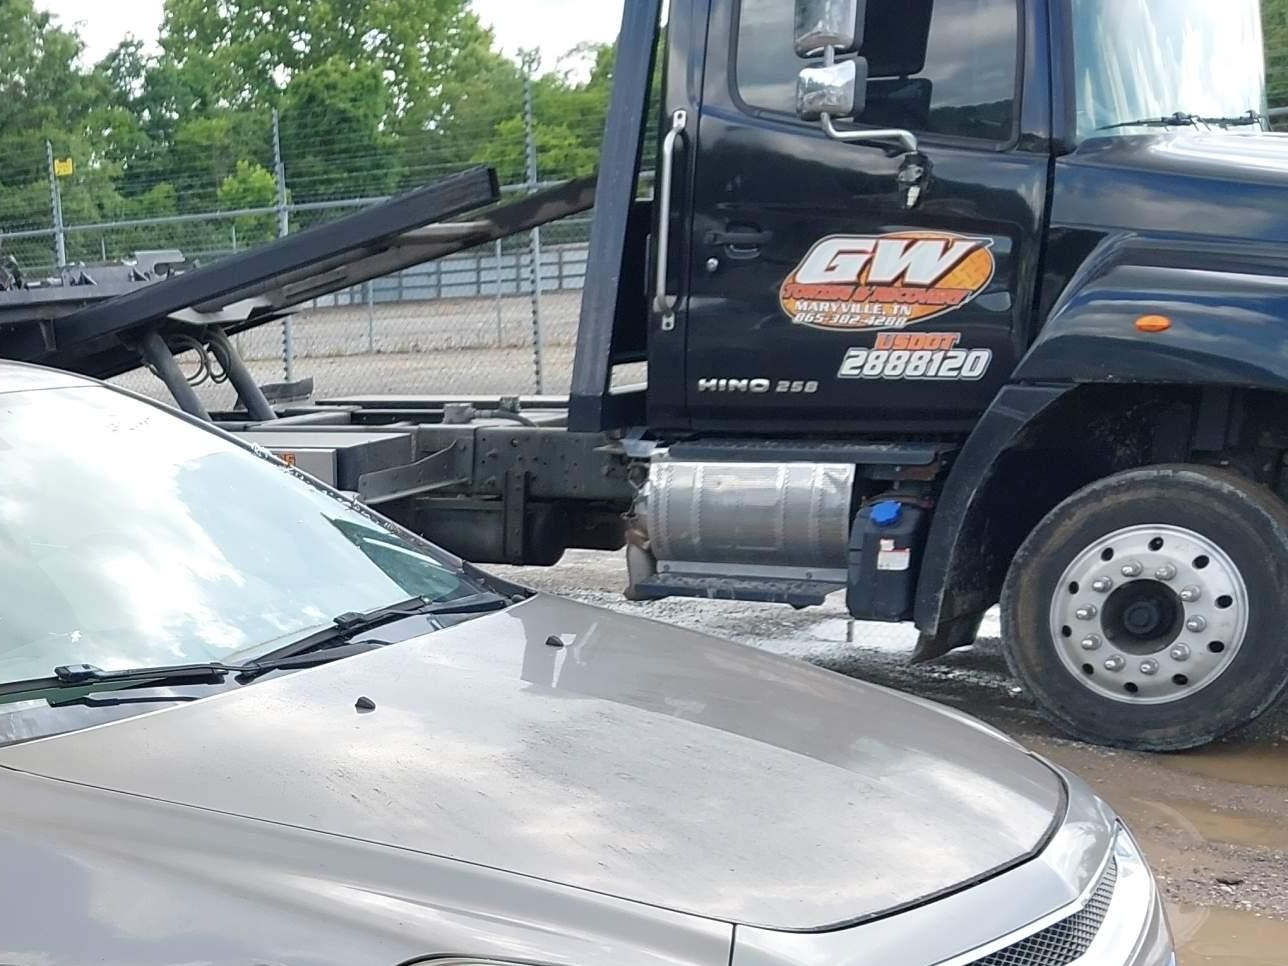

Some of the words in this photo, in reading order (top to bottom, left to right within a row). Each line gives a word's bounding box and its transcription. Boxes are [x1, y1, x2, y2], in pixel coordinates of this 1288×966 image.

[794, 237, 982, 286] GW
[891, 302, 913, 317] TN
[875, 333, 958, 350] USDOT
[839, 349, 991, 377] 2888120
[697, 378, 771, 393] HINO
